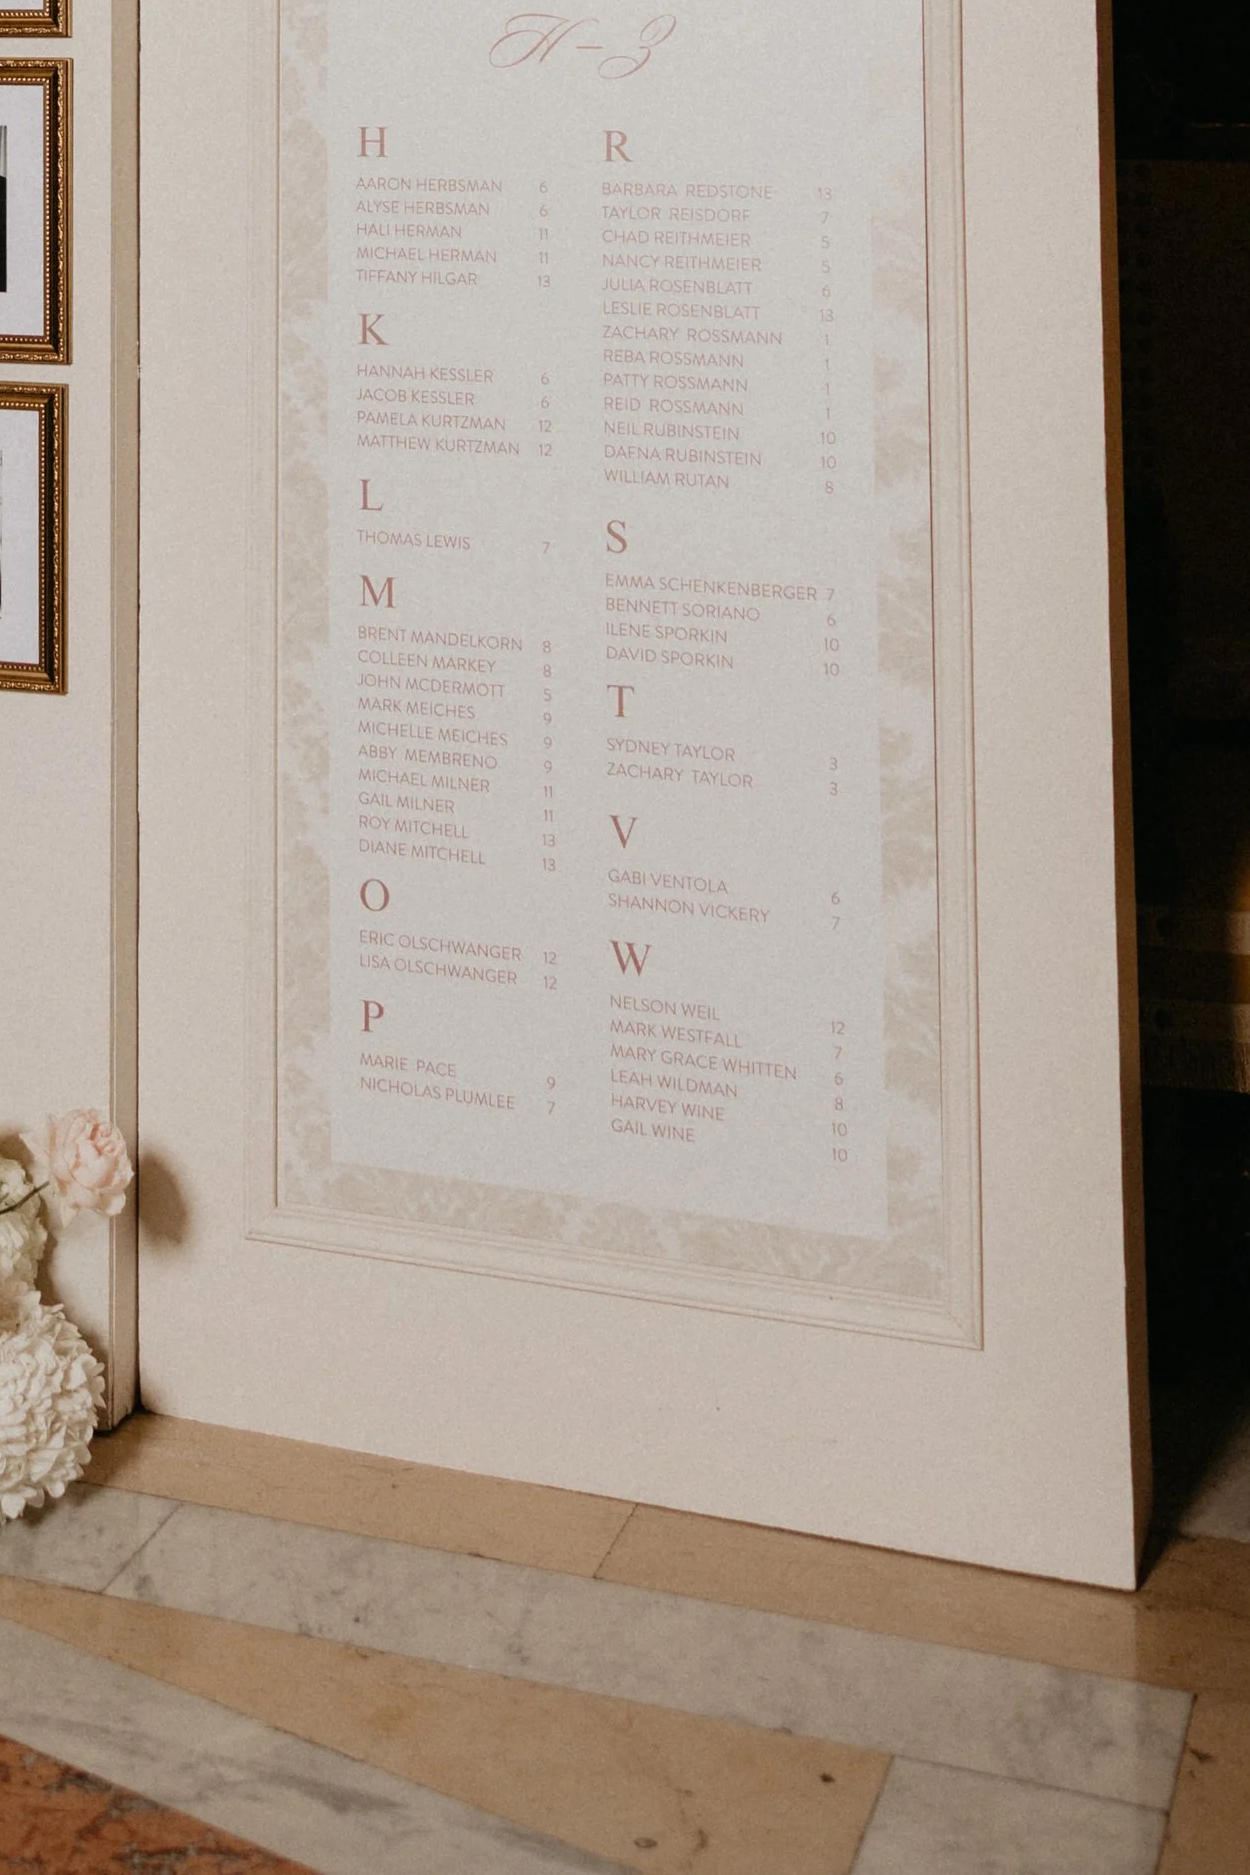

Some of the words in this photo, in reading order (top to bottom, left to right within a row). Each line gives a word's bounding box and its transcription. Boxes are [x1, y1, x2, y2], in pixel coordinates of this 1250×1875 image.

[357, 126, 388, 158] H
[603, 130, 633, 163] R
[355, 176, 411, 190] AARON
[415, 178, 502, 192] HERBSMAN
[601, 229, 649, 244] CHAD
[653, 230, 751, 247] REITHMEIER
[602, 253, 661, 268] NANCY
[664, 254, 762, 271] REITHMEIER
[354, 268, 418, 283] TIFFANY
[420, 271, 477, 286] HILGAR
[358, 313, 389, 345] K
[356, 387, 407, 402] JACOB
[410, 389, 475, 406] KESSLER
[356, 410, 417, 426] PAMELA
[421, 413, 506, 430] KURTZMAN
[603, 444, 660, 460] DAFNA
[665, 447, 762, 466] RUBINSTEIN
[360, 478, 383, 511] L
[355, 529, 422, 547] THOMAS
[425, 533, 470, 550] LEWIS
[605, 519, 628, 554] S
[359, 574, 395, 608] M
[604, 573, 654, 589] EMMA
[659, 575, 817, 601] SCHENKENBERGER
[605, 596, 677, 616] BENNETT
[682, 602, 760, 622] SORIANO
[357, 648, 428, 668] COLLEEN
[432, 655, 497, 673] MARKEY
[357, 696, 402, 712] MARK
[405, 700, 475, 719] MEICHES
[605, 683, 635, 719] T
[609, 814, 638, 850] V
[358, 838, 406, 856] DIANE
[410, 843, 487, 865] MITCHELL
[359, 877, 390, 913] O
[608, 892, 694, 915] SHANNON
[698, 901, 770, 924] VICKERY
[358, 928, 393, 946] ERIC
[398, 933, 522, 961] OLSCHWANGER
[610, 939, 652, 977] W
[361, 999, 385, 1034] P
[609, 993, 677, 1016] NELSON
[680, 1002, 721, 1021] WEIL
[609, 1018, 657, 1037] MARK
[661, 1024, 742, 1048] WESTFALL
[359, 1075, 441, 1100] NICHOLAS
[444, 1087, 515, 1110] PLUMLEE
[610, 1092, 676, 1115] HARVEY
[681, 1102, 724, 1121] WINE
